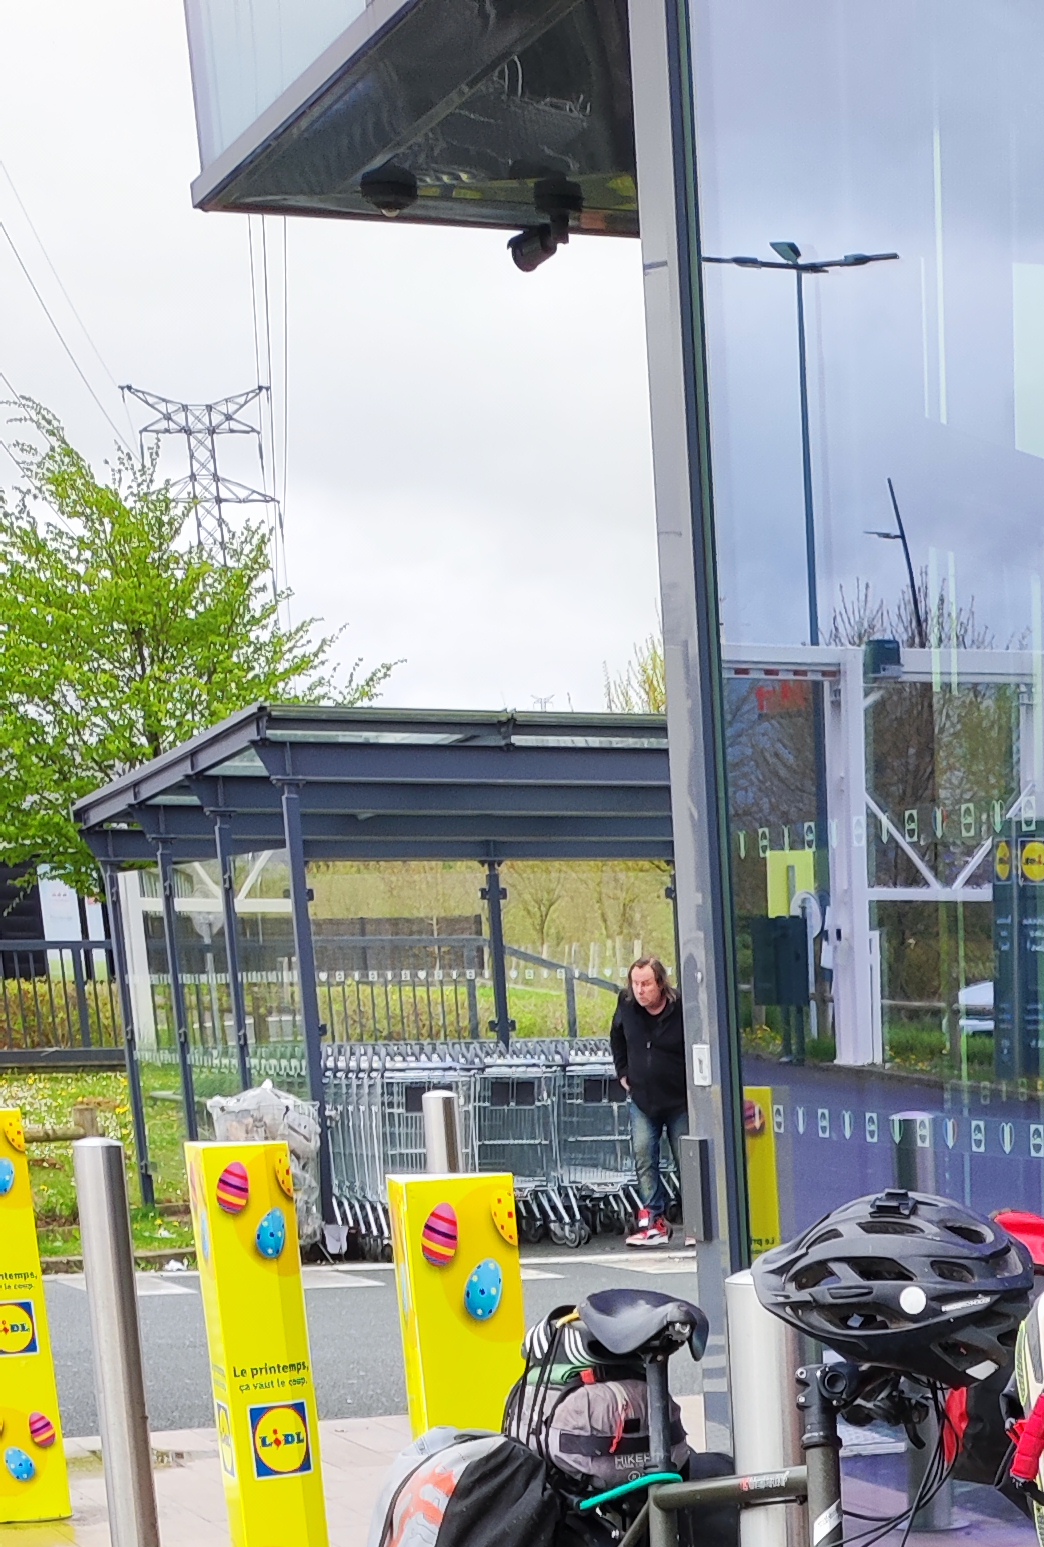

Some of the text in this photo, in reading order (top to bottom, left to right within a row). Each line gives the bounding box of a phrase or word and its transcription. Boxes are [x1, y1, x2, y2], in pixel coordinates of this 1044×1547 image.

[0, 1271, 38, 1281] ntemps,
[233, 1361, 310, 1380] Le printemps,
